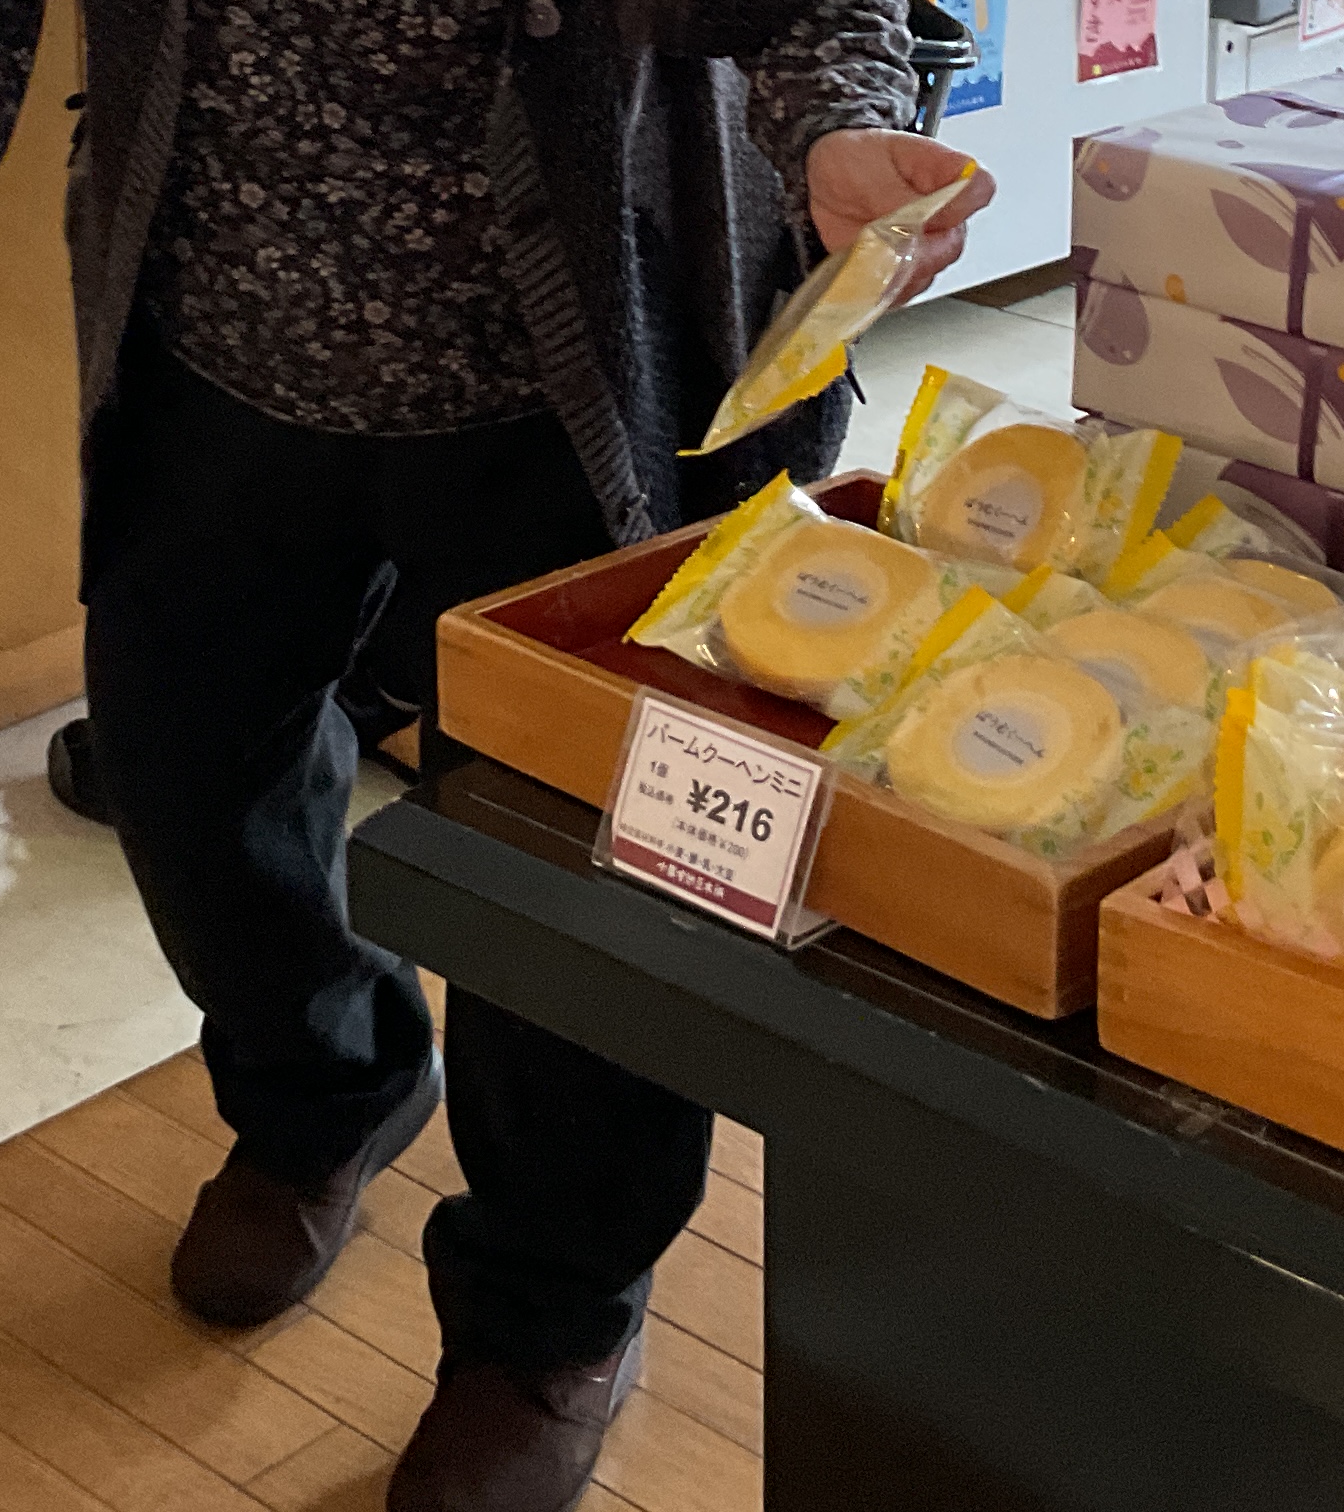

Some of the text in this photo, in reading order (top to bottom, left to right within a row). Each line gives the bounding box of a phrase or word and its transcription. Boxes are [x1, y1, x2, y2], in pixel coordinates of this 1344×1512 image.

[647, 723, 801, 798] バームクーヘンミニ
[686, 779, 774, 842] ¥216
